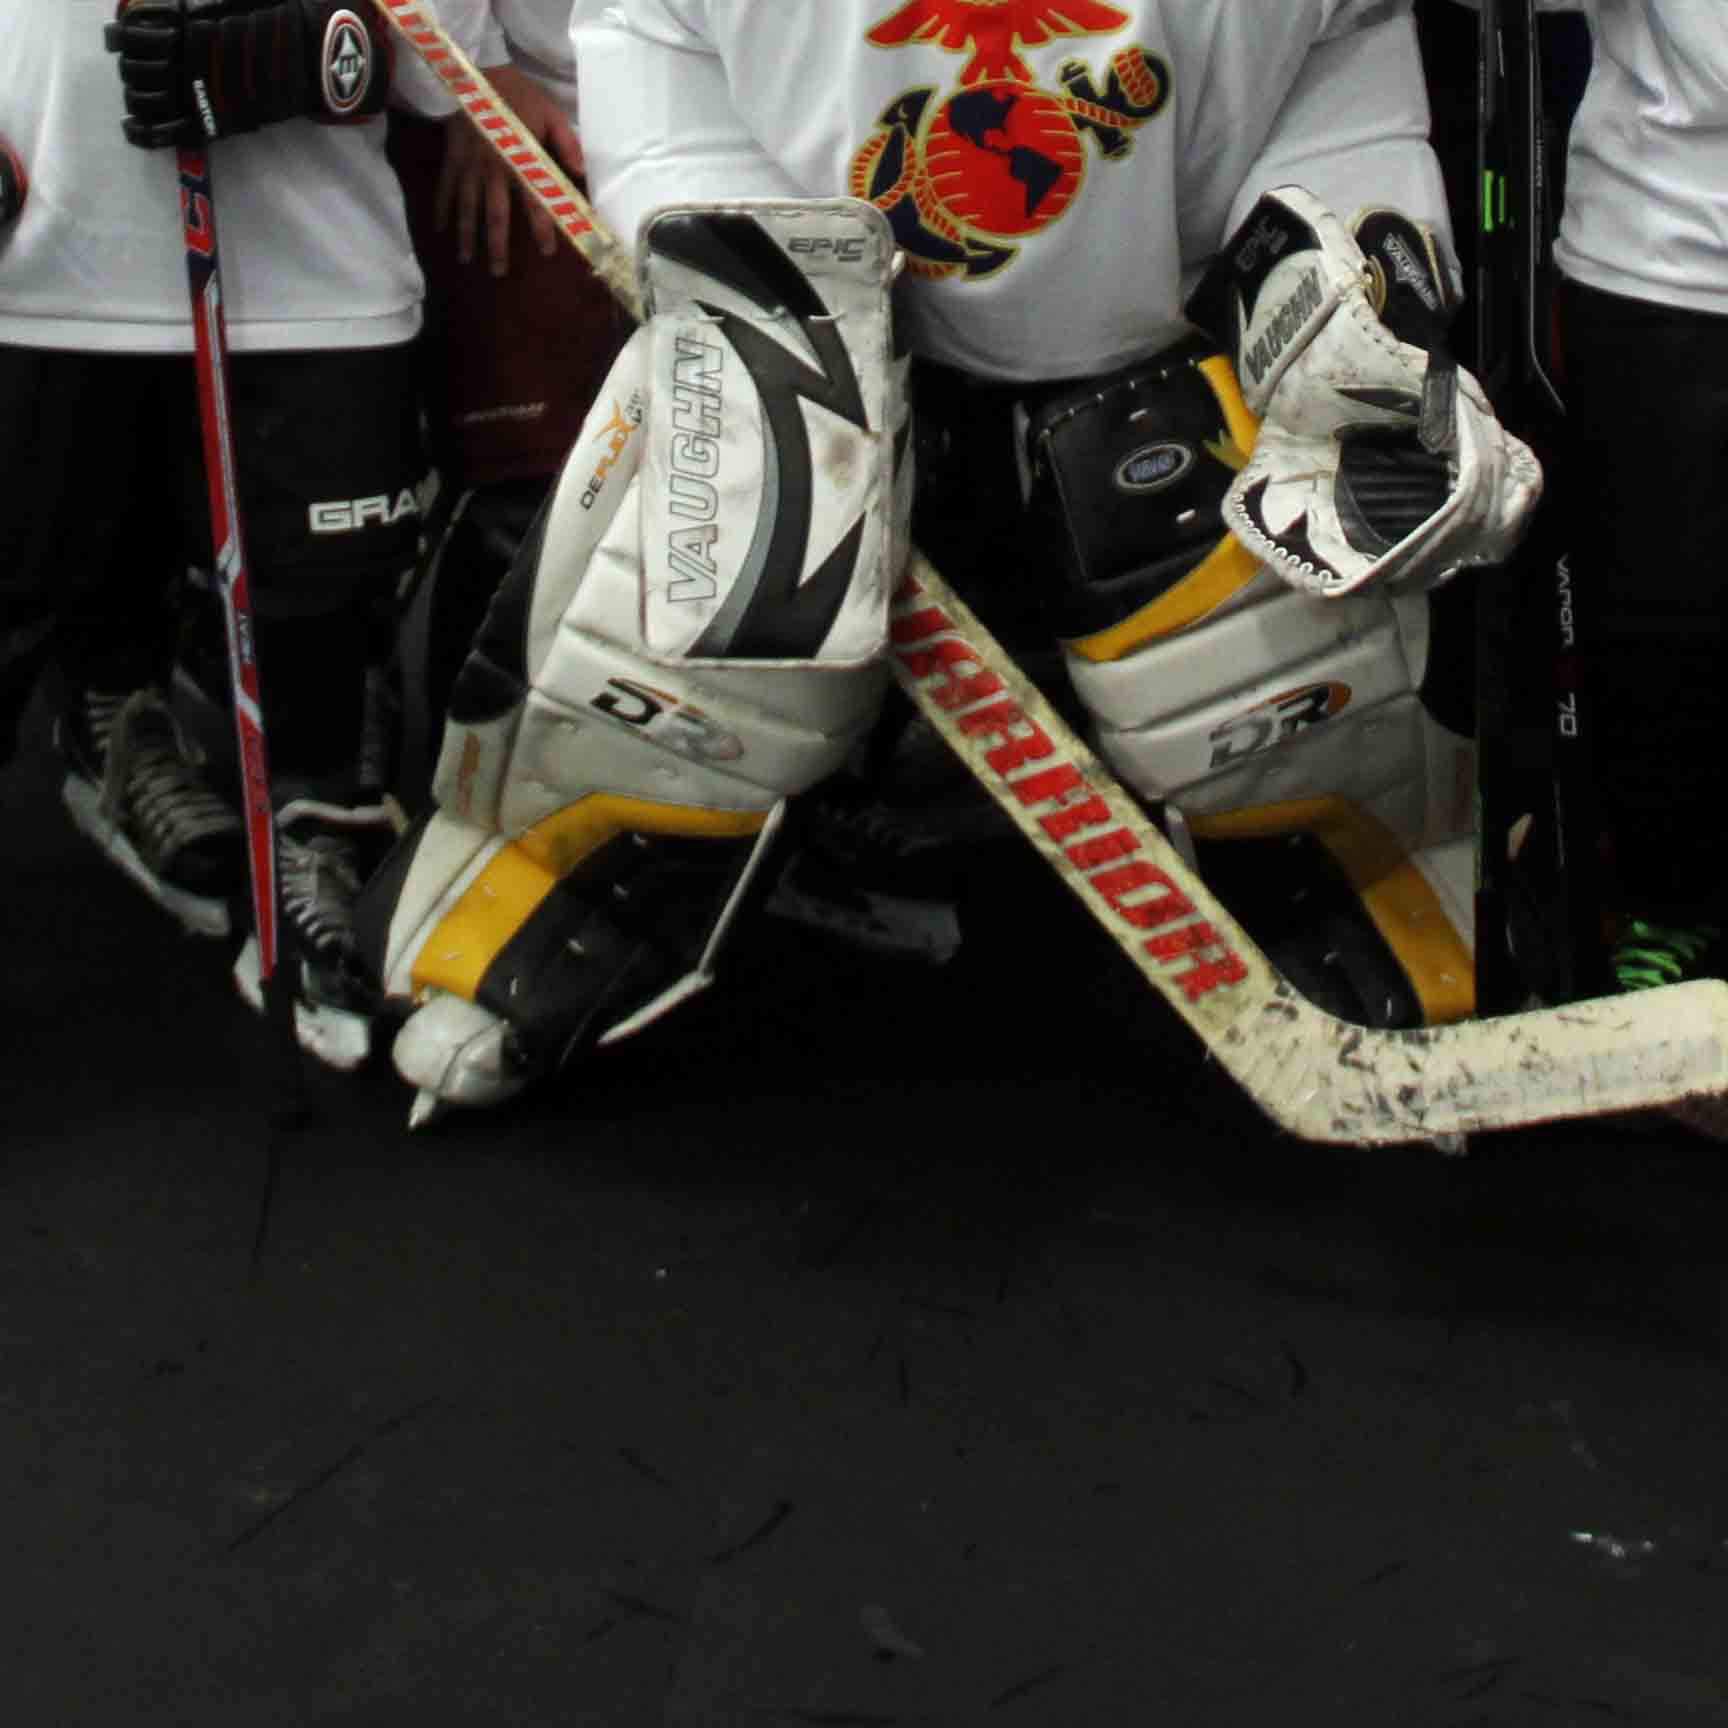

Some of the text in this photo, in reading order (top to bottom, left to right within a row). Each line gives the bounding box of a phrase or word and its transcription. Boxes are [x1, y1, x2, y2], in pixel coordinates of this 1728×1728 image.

[787, 236, 868, 263] EPIC
[666, 336, 725, 605] VAUGHN
[306, 487, 419, 535] GRA
